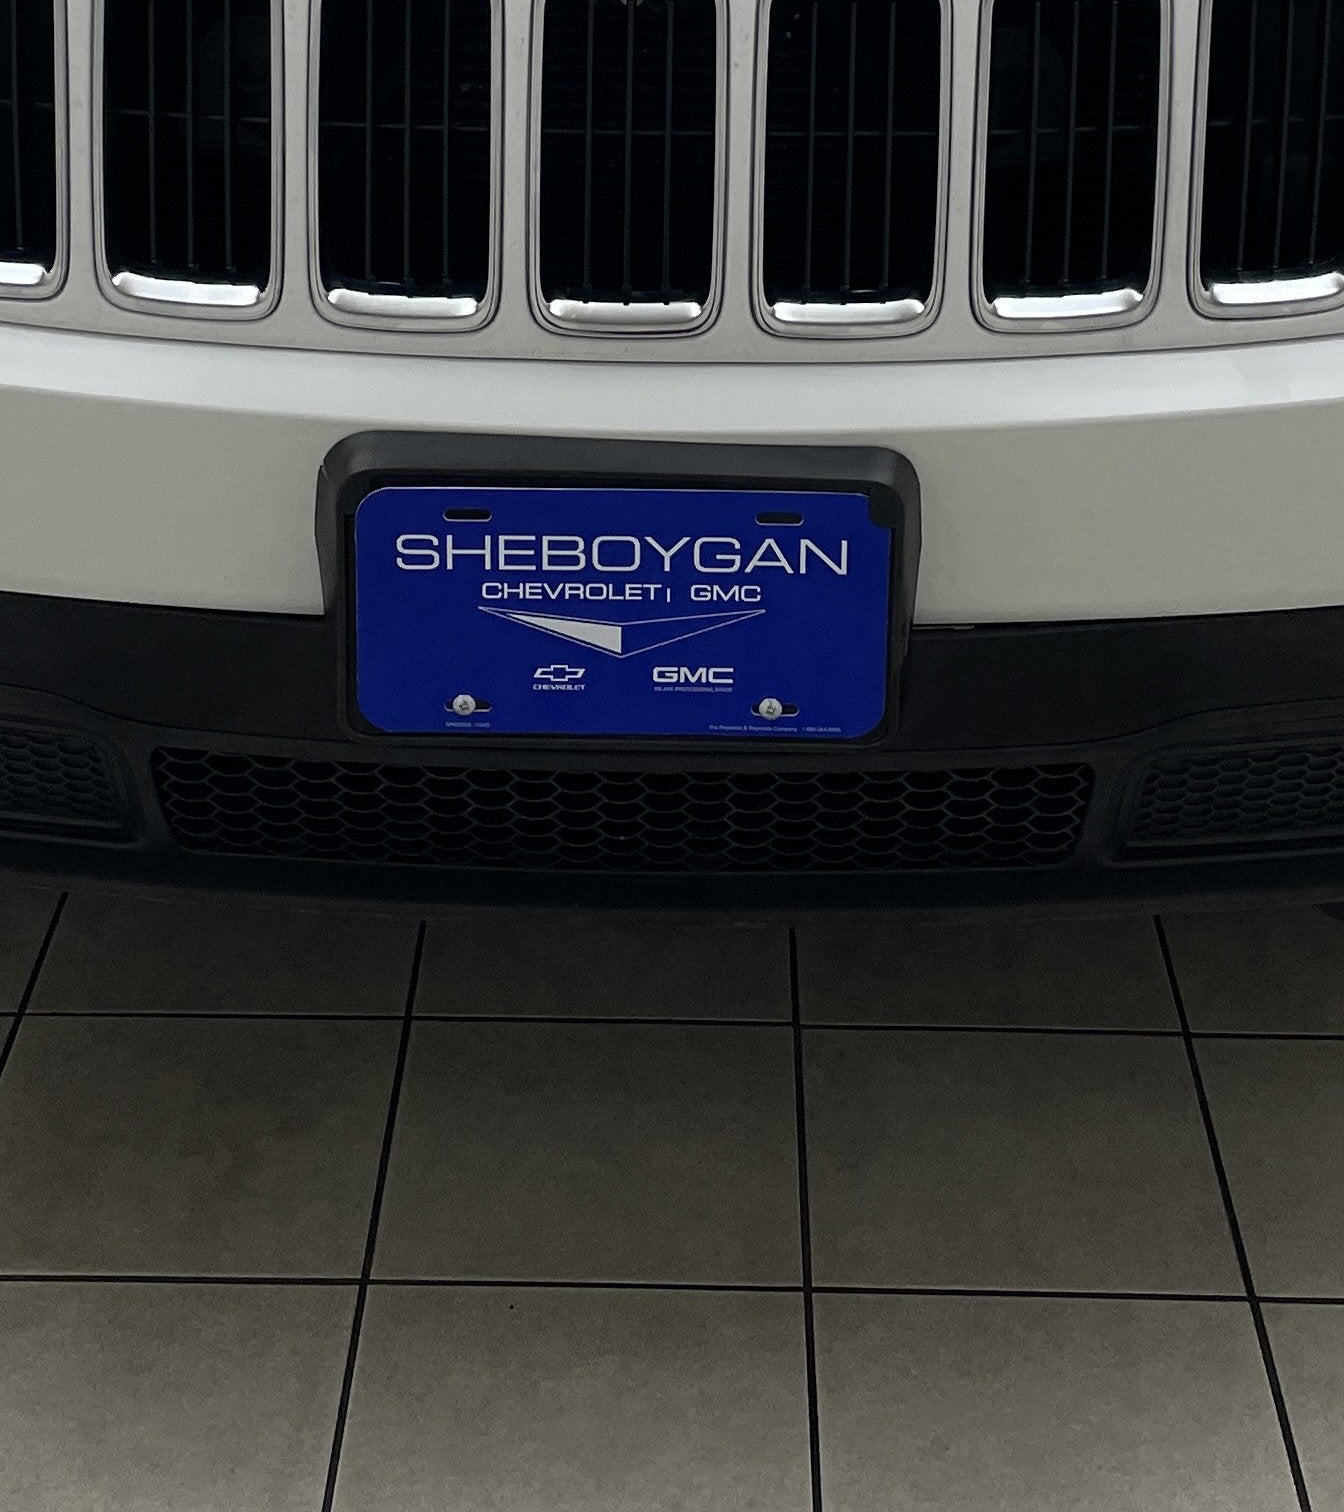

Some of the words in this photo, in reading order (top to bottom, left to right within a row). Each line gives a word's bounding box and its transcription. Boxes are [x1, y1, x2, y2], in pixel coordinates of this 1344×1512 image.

[396, 534, 848, 576] SHEBOYGAN
[482, 582, 662, 601] CHEVROLET
[690, 584, 762, 602] GMC
[653, 667, 734, 684] GMC
